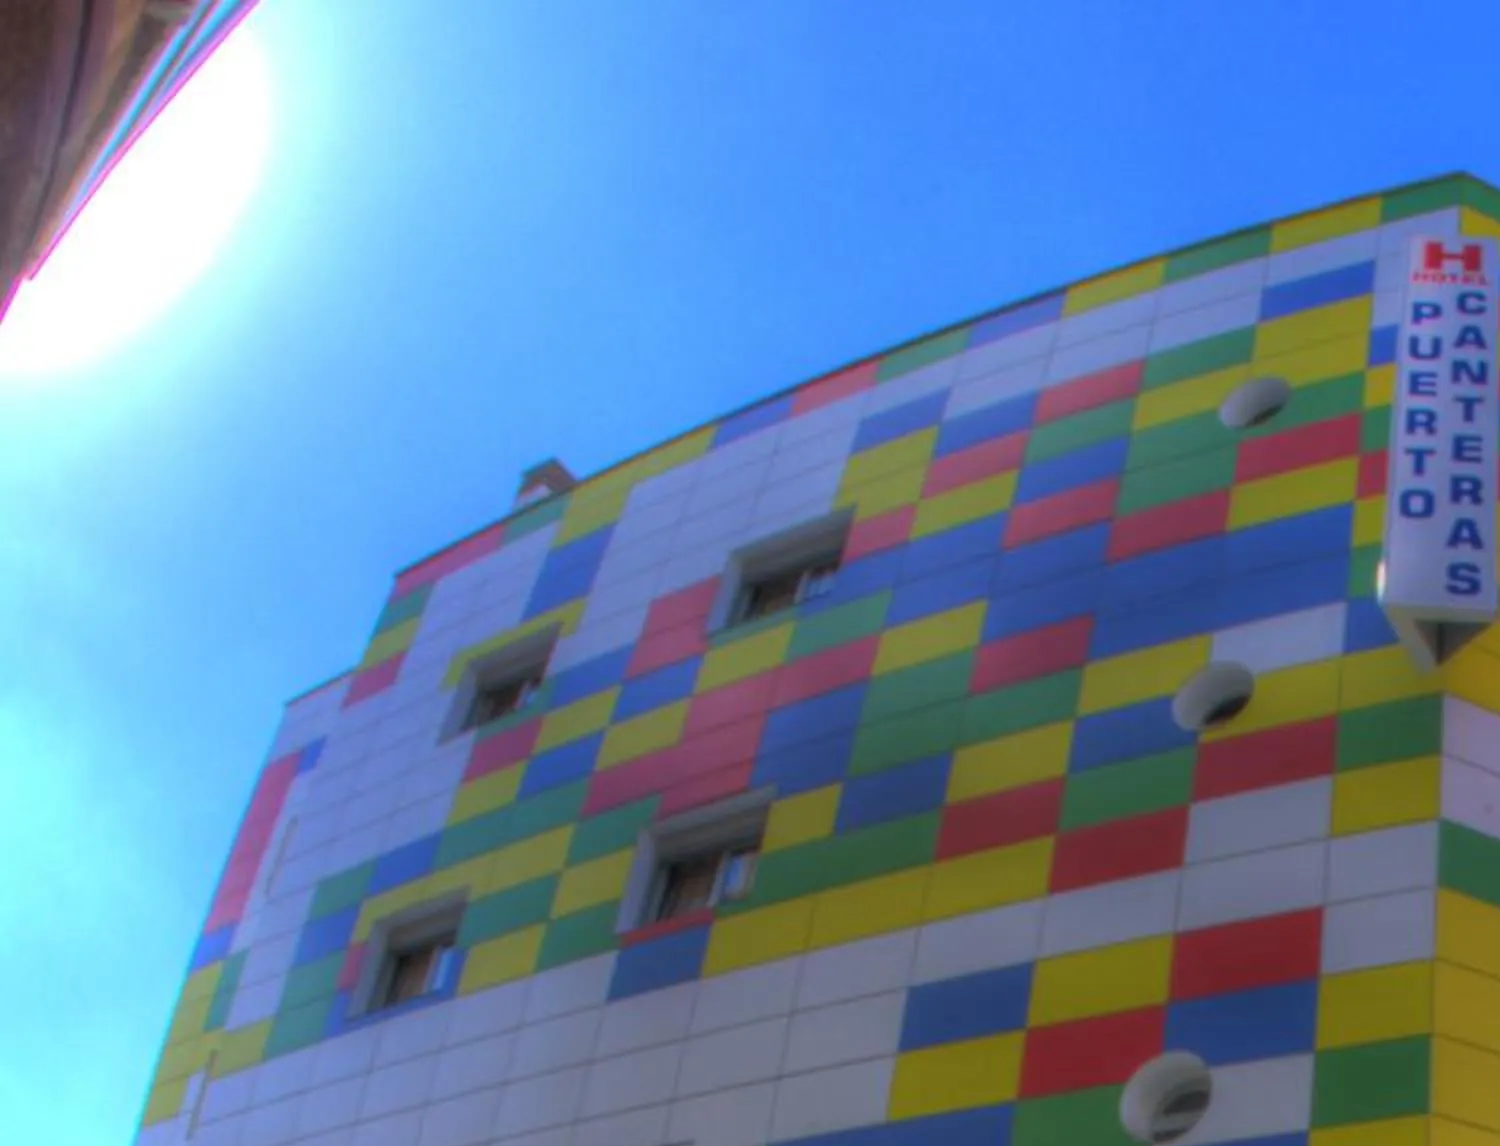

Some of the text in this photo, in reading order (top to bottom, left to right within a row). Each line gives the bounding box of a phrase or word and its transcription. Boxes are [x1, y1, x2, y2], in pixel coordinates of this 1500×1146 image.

[1411, 271, 1489, 287] HOTEL
[1424, 241, 1482, 272] H
[1400, 301, 1443, 520] PUERTO
[1445, 290, 1489, 596] CANTERAS
